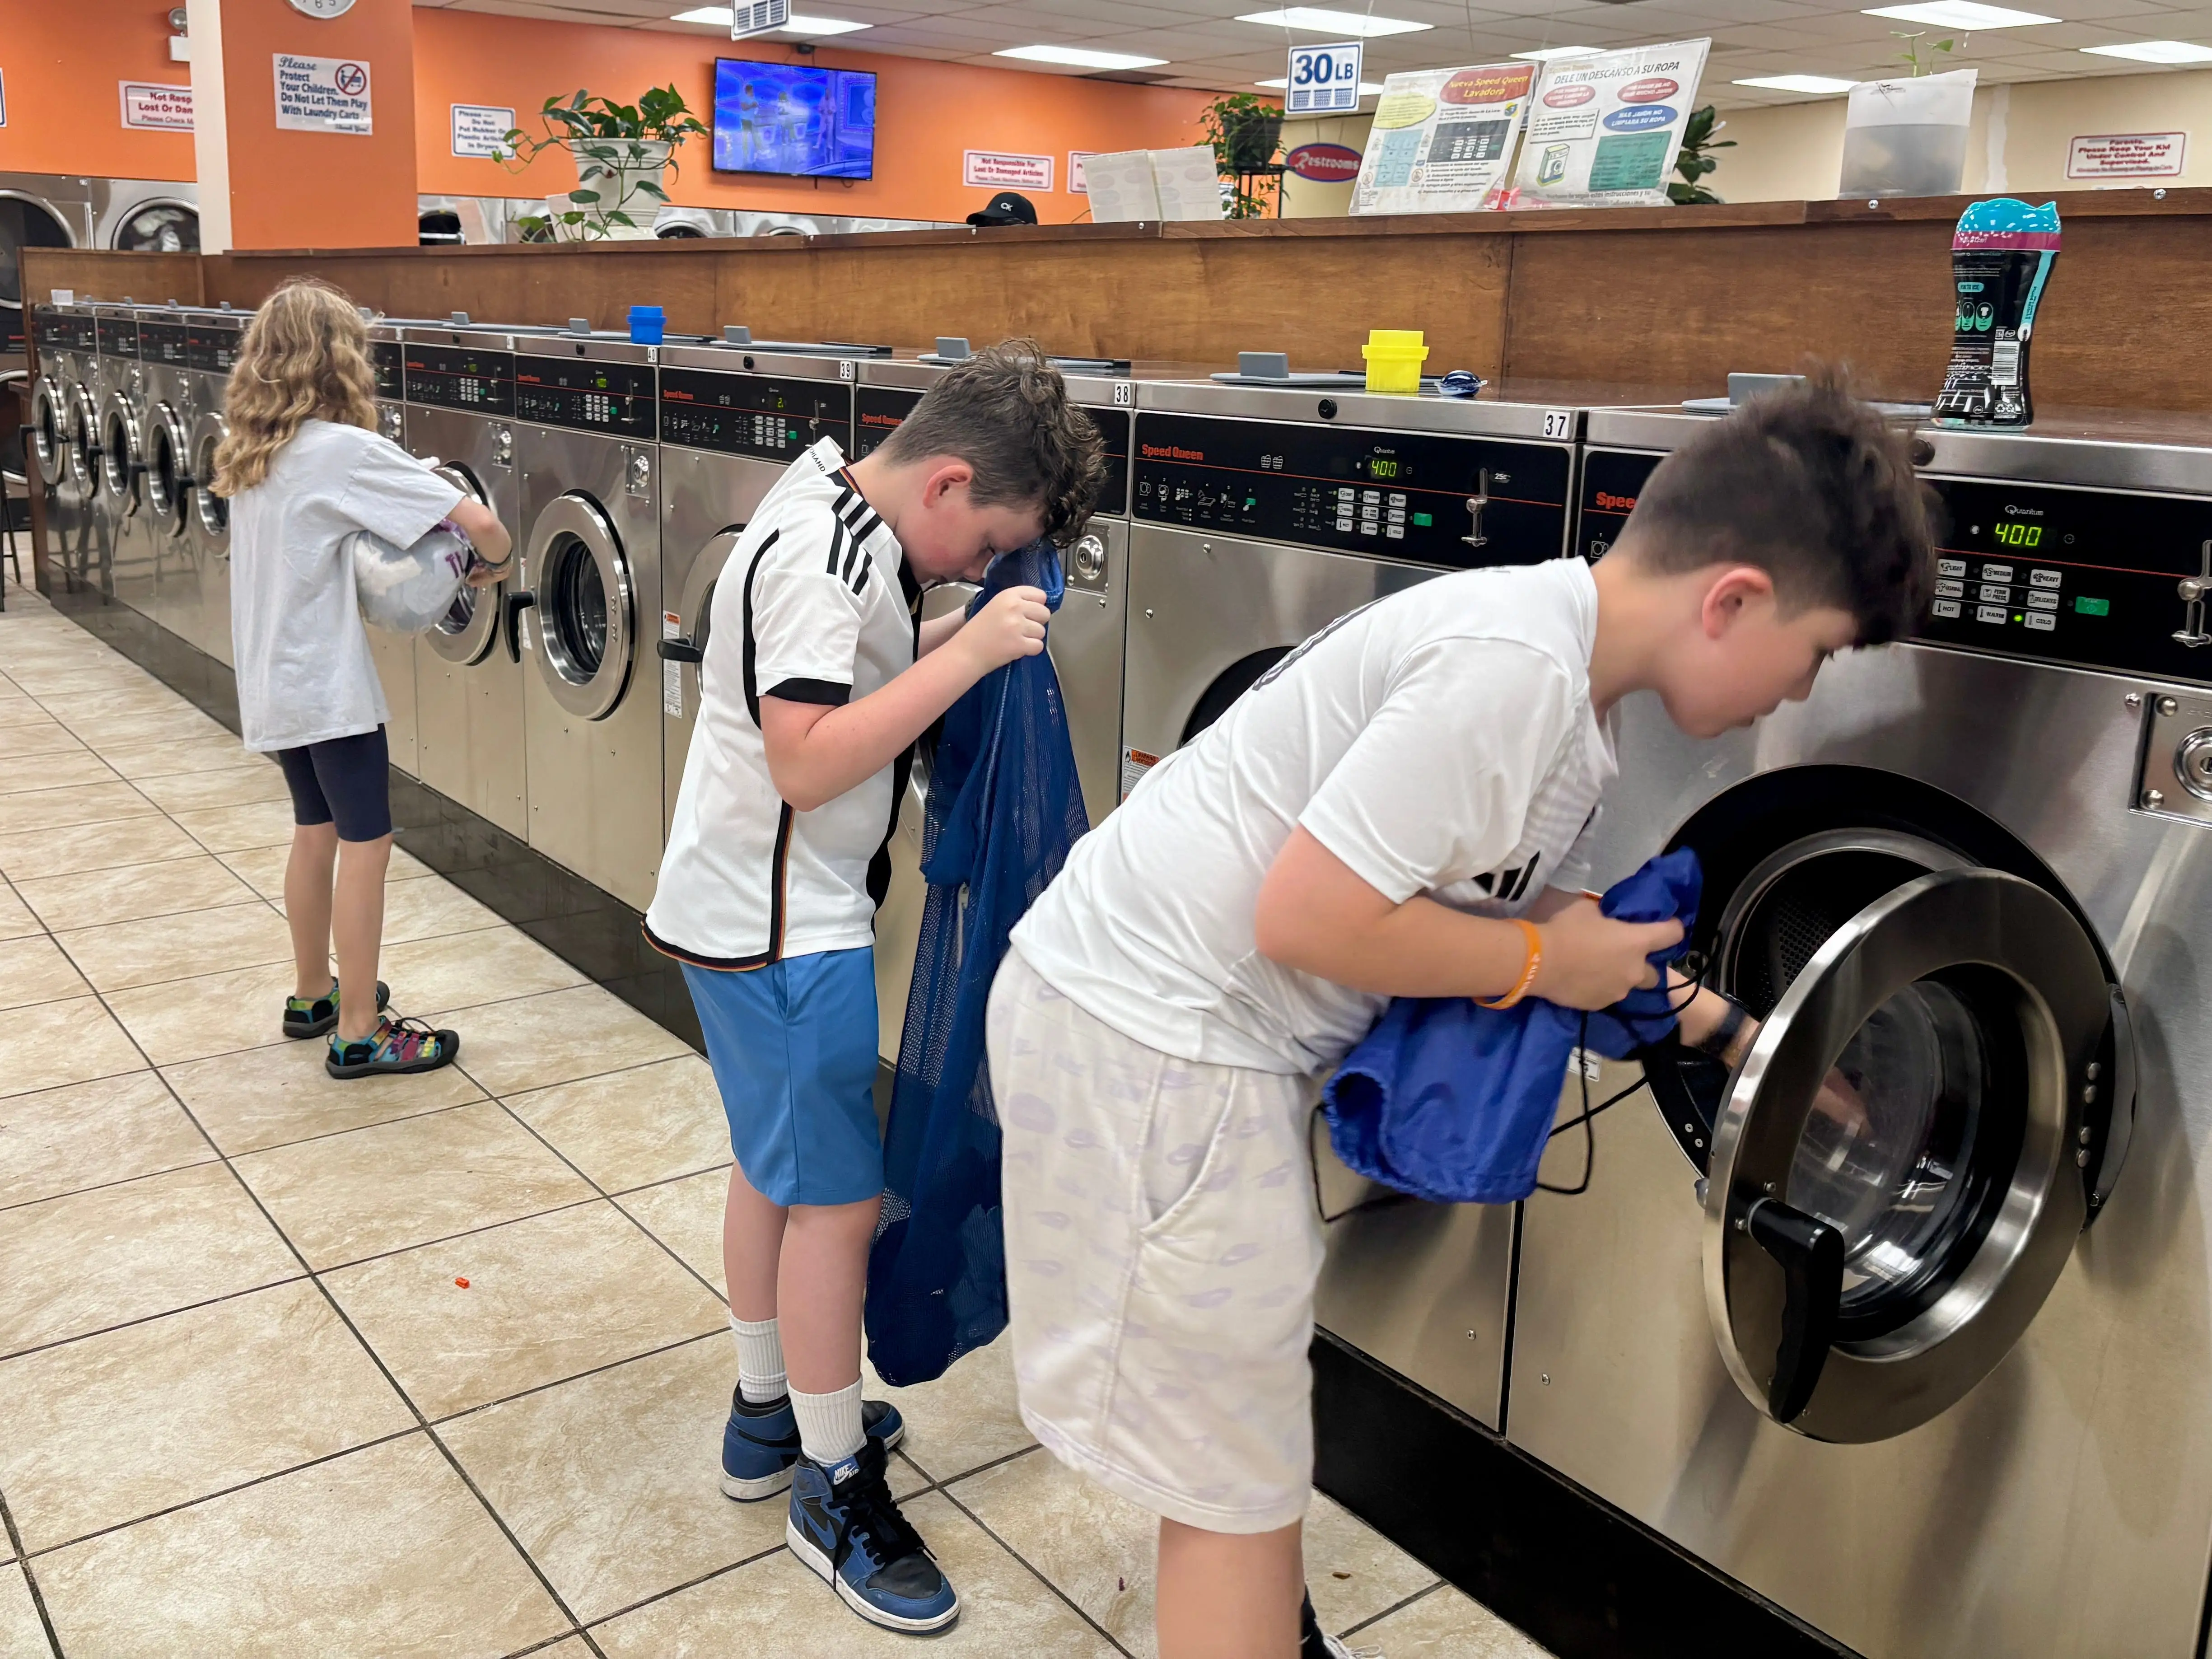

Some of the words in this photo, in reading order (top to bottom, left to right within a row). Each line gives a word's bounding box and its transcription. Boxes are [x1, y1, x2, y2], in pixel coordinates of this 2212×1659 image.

[279, 56, 317, 70] Please
[1294, 53, 1332, 84] 30
[1335, 63, 1353, 80] LB
[280, 70, 310, 82] Protect
[1554, 72, 1574, 84] DELE
[1575, 72, 1588, 82] UN
[1589, 66, 1633, 80] DESCANSO
[1633, 67, 1641, 75] A
[1641, 64, 1654, 74] SU
[1654, 61, 1680, 72] ROPA
[280, 81, 300, 92] Your
[1474, 77, 1501, 87] Speed
[1502, 76, 1528, 85] Queen
[150, 92, 166, 101] Not
[1464, 88, 1506, 98] Lavadora
[139, 103, 159, 112] Lost
[281, 92, 293, 102] Do
[294, 93, 310, 104] Not
[312, 95, 325, 105] Let
[327, 96, 349, 107] Them
[350, 98, 367, 111] Play
[281, 104, 302, 115] With
[303, 107, 337, 120] Laundry
[1294, 152, 1359, 170] Restrooms
[841, 363, 850, 378] 39
[1116, 386, 1128, 403] 38
[1545, 414, 1566, 436] 37
[1142, 444, 1172, 457] Speed
[1172, 446, 1204, 460] Queen
[1372, 460, 1397, 477] 400
[1596, 491, 1637, 509] Spee
[1995, 523, 2042, 547] 400
[835, 1464, 849, 1480] NIKE
